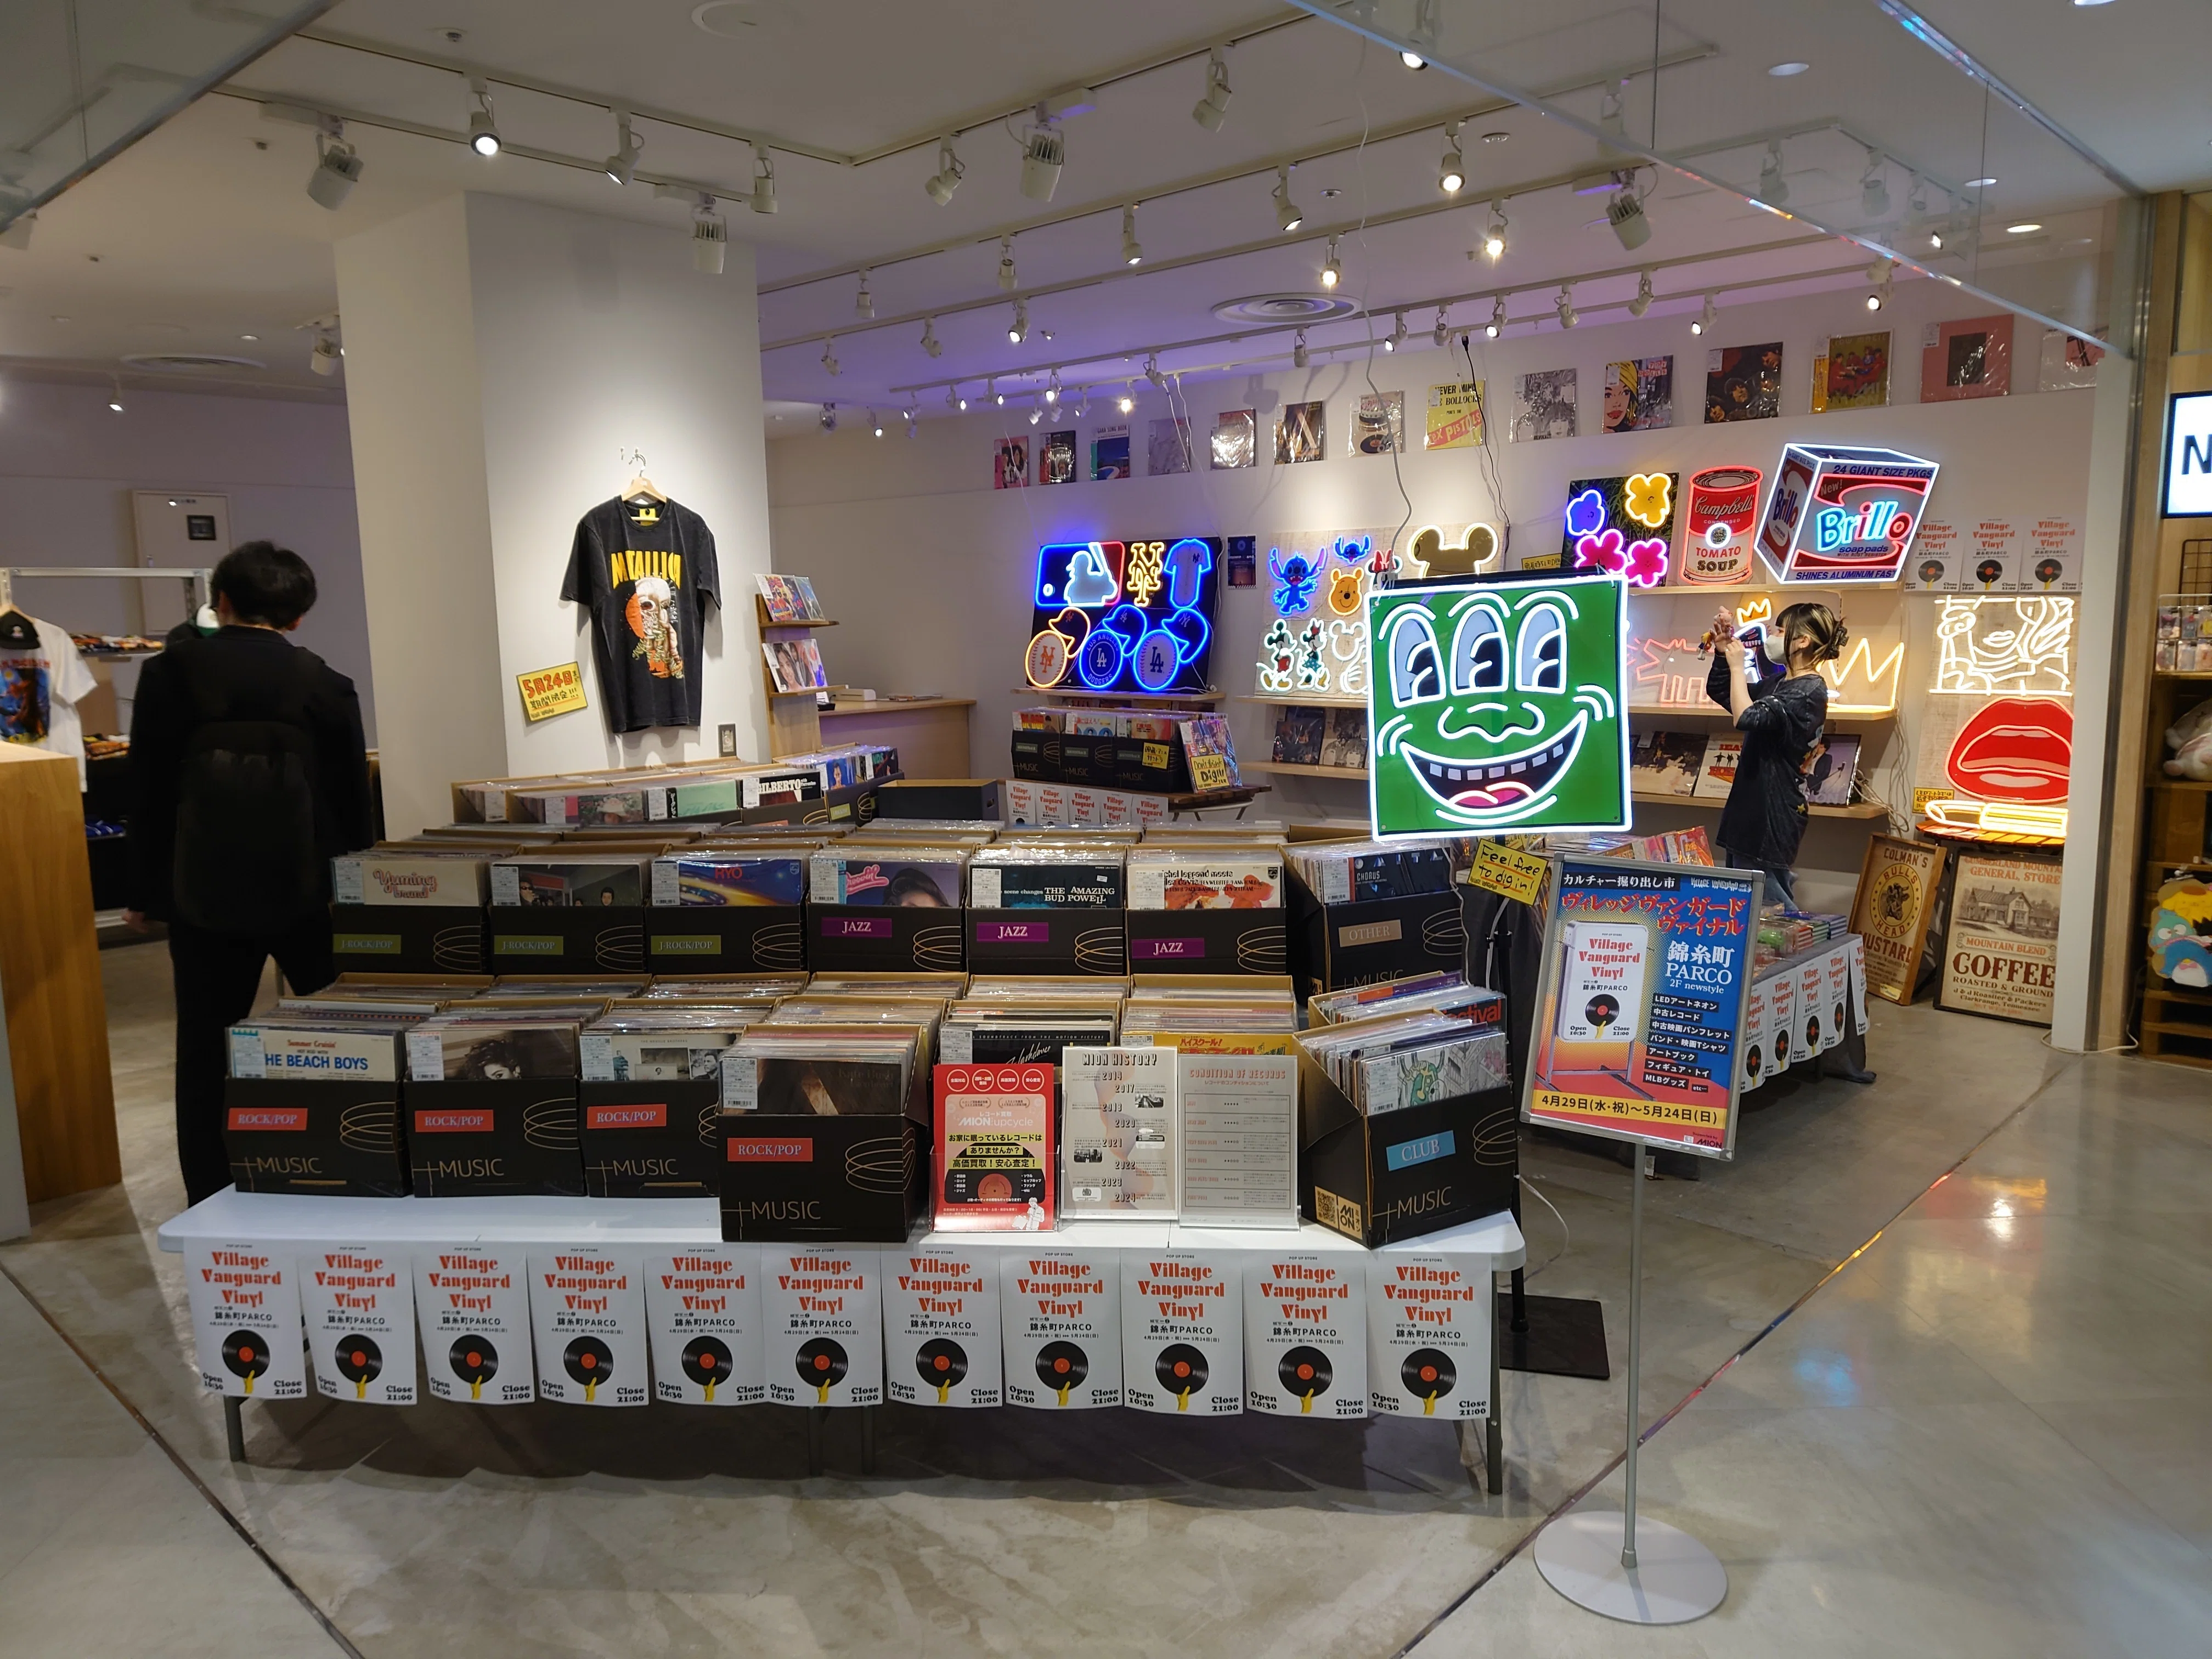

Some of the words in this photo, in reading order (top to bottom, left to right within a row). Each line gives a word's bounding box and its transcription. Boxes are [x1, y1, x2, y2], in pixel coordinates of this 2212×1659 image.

[1833, 465, 1846, 475] 24
[1849, 466, 1881, 476] GIANT
[1883, 467, 1906, 477] SIZE
[1908, 469, 1934, 478] PKGS
[1820, 479, 1843, 496] New!
[1817, 501, 1913, 551] Brillo
[1979, 522, 2010, 531] Village
[1973, 531, 2015, 539] Vanguard
[1865, 545, 1888, 554] pads
[1982, 540, 2004, 549] Vinyl
[1696, 546, 1741, 558] TOMATO
[1697, 558, 1738, 572] SOUP
[1796, 571, 1829, 580] SHINES
[1830, 571, 1874, 579] ALUMINUM
[1876, 570, 1896, 578] FAST
[1481, 844, 1513, 866] Feel
[1514, 856, 1541, 876] free
[1883, 848, 1928, 868] COLMAN'S
[715, 867, 742, 879] RYO
[1181, 870, 1209, 878] legrand
[1357, 871, 1380, 882] CHORUS
[1479, 865, 1492, 877] to
[1496, 870, 1513, 889] dig
[1883, 865, 1918, 884] BULL'S
[2024, 871, 2061, 884] STORE
[1564, 873, 1675, 889] カルチャー掘り出し市
[1691, 877, 1709, 888] VILLAGE
[1070, 886, 1115, 895] AMAZING
[1067, 895, 1106, 904] POWELL
[1562, 891, 1747, 917] ヴィレッジヴァンガード
[842, 921, 871, 934] JAZZ
[1657, 914, 1745, 936] ヴァイナル
[1876, 921, 1905, 936] HEAD
[997, 926, 1028, 939] JAZZ
[1349, 926, 1390, 941] OTHER
[341, 939, 393, 950] J-ROCK/POP
[502, 940, 555, 951] J-ROCK/POP
[658, 939, 713, 951] J-ROCK/POP
[1153, 942, 1183, 956] JAZZ
[1589, 938, 1633, 952] Village
[1966, 937, 2014, 952] MOUNTAIN
[2017, 944, 2046, 956] BLEND
[1579, 951, 1640, 965] Vanguard
[1667, 940, 1735, 968] 錦糸町
[1592, 966, 1624, 980] Vinyl
[1666, 962, 1733, 985] PARCO
[1953, 952, 2056, 989] COFFEE
[1670, 979, 1683, 988] 2F
[1684, 983, 1724, 994] newstyle
[1953, 976, 1997, 989] ROASTED
[2012, 985, 2053, 998] GROUND
[1655, 996, 1717, 1010] LEDアートネオン
[1654, 1008, 1700, 1021] 中古レコード
[1082, 1053, 1108, 1065] MION
[1112, 1054, 1157, 1066] HISTORY
[1649, 1047, 1696, 1061] アートブック
[265, 1053, 282, 1066] HE
[287, 1054, 329, 1068] BEACH
[334, 1057, 368, 1070] BOYS
[1102, 1071, 1122, 1080] 2014
[1645, 1074, 1686, 1088] MLBグッズ
[1115, 1084, 1135, 1093] 2017
[1102, 1103, 1122, 1112] 2018
[238, 1113, 297, 1125] ROCK/POP
[424, 1114, 483, 1127] ROCK/POP
[596, 1110, 656, 1123] ROCK/POP
[994, 1117, 1034, 1128] upcycle
[1115, 1119, 1135, 1128] 2020
[1102, 1138, 1122, 1147] 2021
[1696, 1138, 1722, 1148] MION
[738, 1143, 802, 1157] ROCK/POP
[1401, 1139, 1440, 1162] CLUB
[1115, 1193, 1136, 1202] 2024
[213, 1251, 268, 1270] Village
[673, 1257, 732, 1274] Village
[790, 1257, 851, 1275] Village
[910, 1259, 970, 1277] Village
[1029, 1260, 1091, 1279] Village
[1150, 1262, 1212, 1281] Village
[202, 1268, 281, 1286] Vanguard
[1396, 1266, 1460, 1286] Village
[662, 1276, 745, 1292] Vanguard
[778, 1276, 864, 1293] Vanguard
[898, 1276, 983, 1295] Vanguard
[1018, 1279, 1103, 1297] Vanguard
[1138, 1280, 1224, 1299] Vanguard
[222, 1289, 263, 1307] Vinyl
[1384, 1284, 1474, 1304] Vanguard
[682, 1296, 726, 1313] Vinyl
[799, 1296, 843, 1314] Vinyl
[918, 1297, 962, 1316] Vinyl
[1038, 1300, 1082, 1318] Vinyl
[1159, 1302, 1204, 1321] Vinyl
[1405, 1306, 1452, 1325] Vinyl
[1030, 1323, 1092, 1331] 錦糸町PARCO
[1009, 1385, 1035, 1396] Open
[1091, 1389, 1119, 1397] Close
[1010, 1394, 1035, 1403] 10:30
